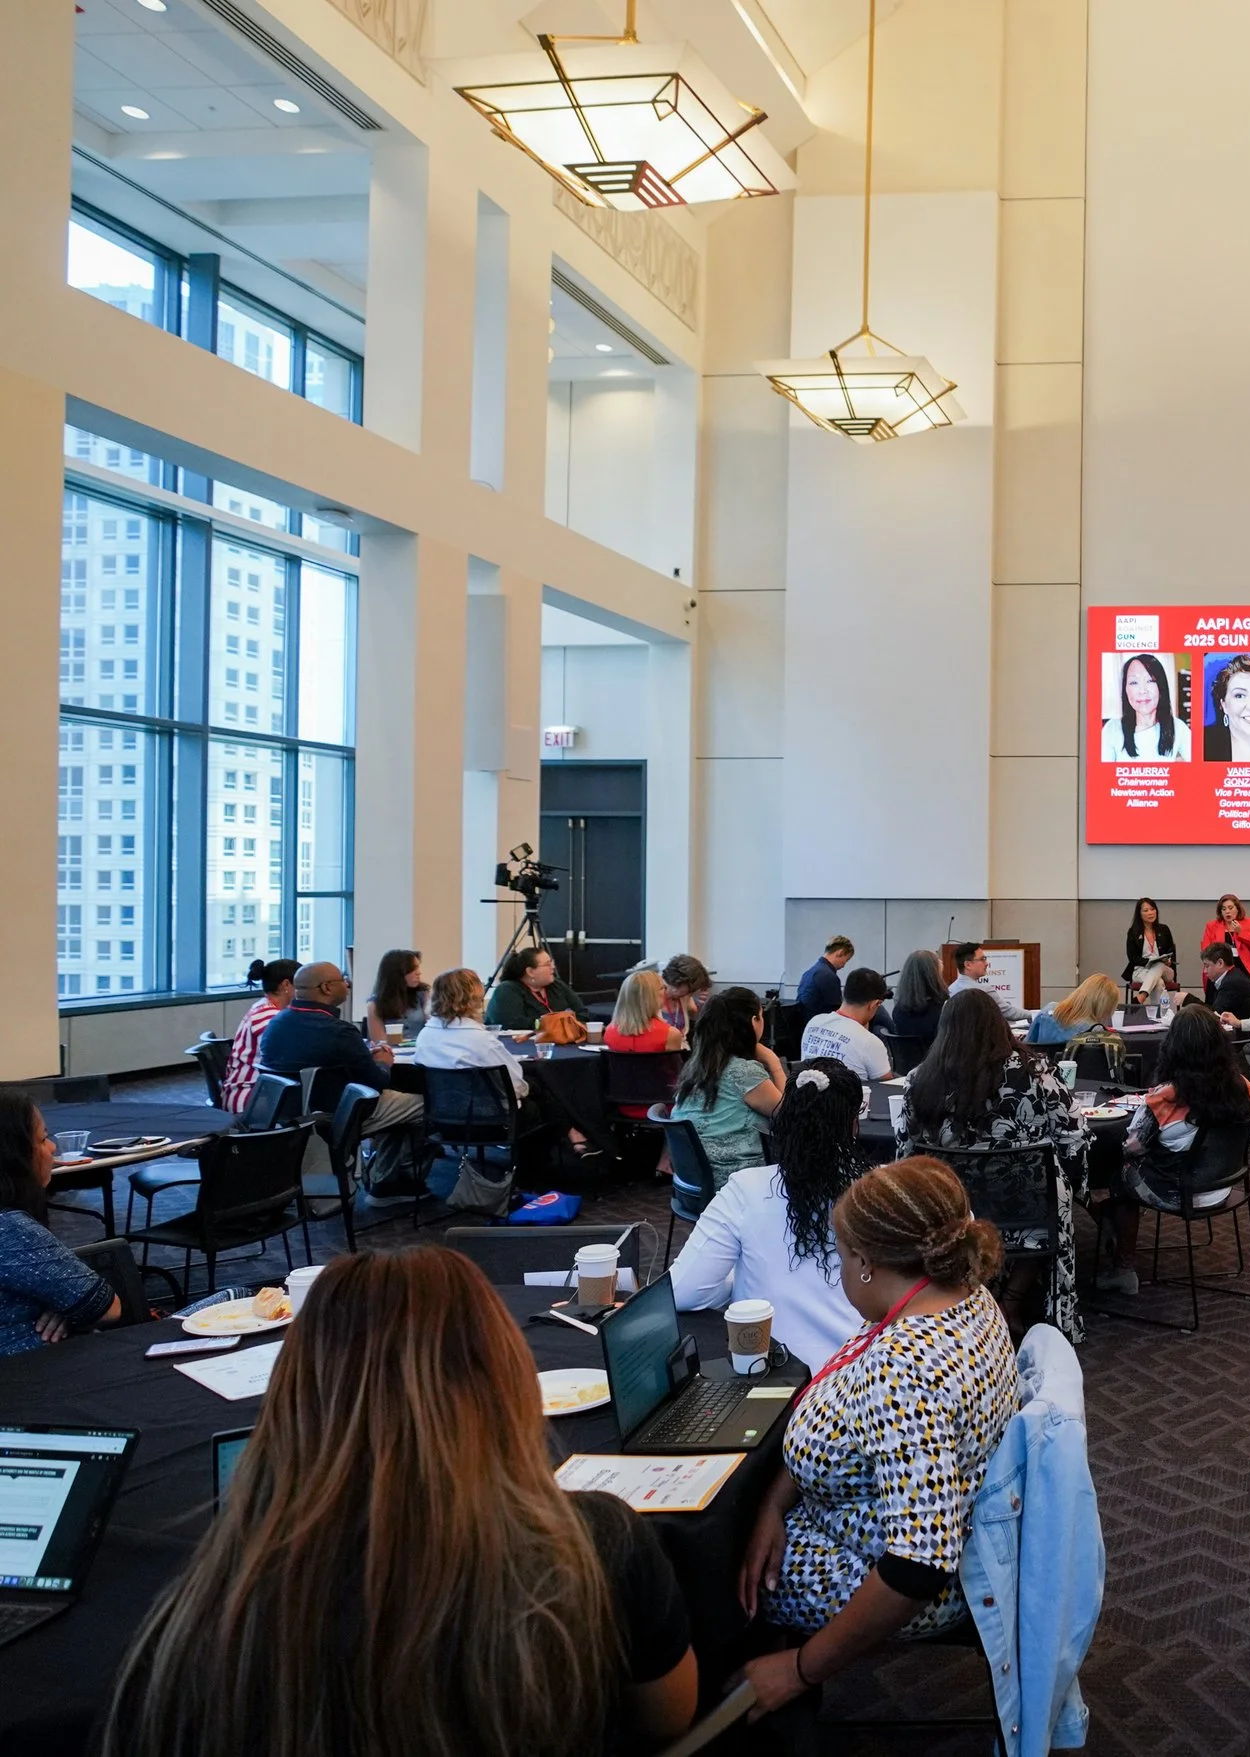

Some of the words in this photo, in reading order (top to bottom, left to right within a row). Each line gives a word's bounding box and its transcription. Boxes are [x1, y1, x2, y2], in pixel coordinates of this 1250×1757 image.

[1196, 618, 1229, 630] AAPI
[1117, 641, 1157, 649] VIOLENCE
[1184, 634, 1215, 647] 2025
[1217, 634, 1248, 647] GUN
[545, 732, 573, 746] EXIT
[1115, 767, 1131, 777] PO
[1132, 767, 1170, 777] MURRAY
[1117, 778, 1168, 786] Chairwoman
[1111, 788, 1148, 797] Newtown
[1149, 788, 1175, 797] Action
[1215, 788, 1232, 797] Vice
[1126, 799, 1159, 807] Alliance
[1218, 810, 1250, 818] Political
[807, 1034, 842, 1051] EVERYTOWN
[820, 1048, 846, 1061] SAFETY
